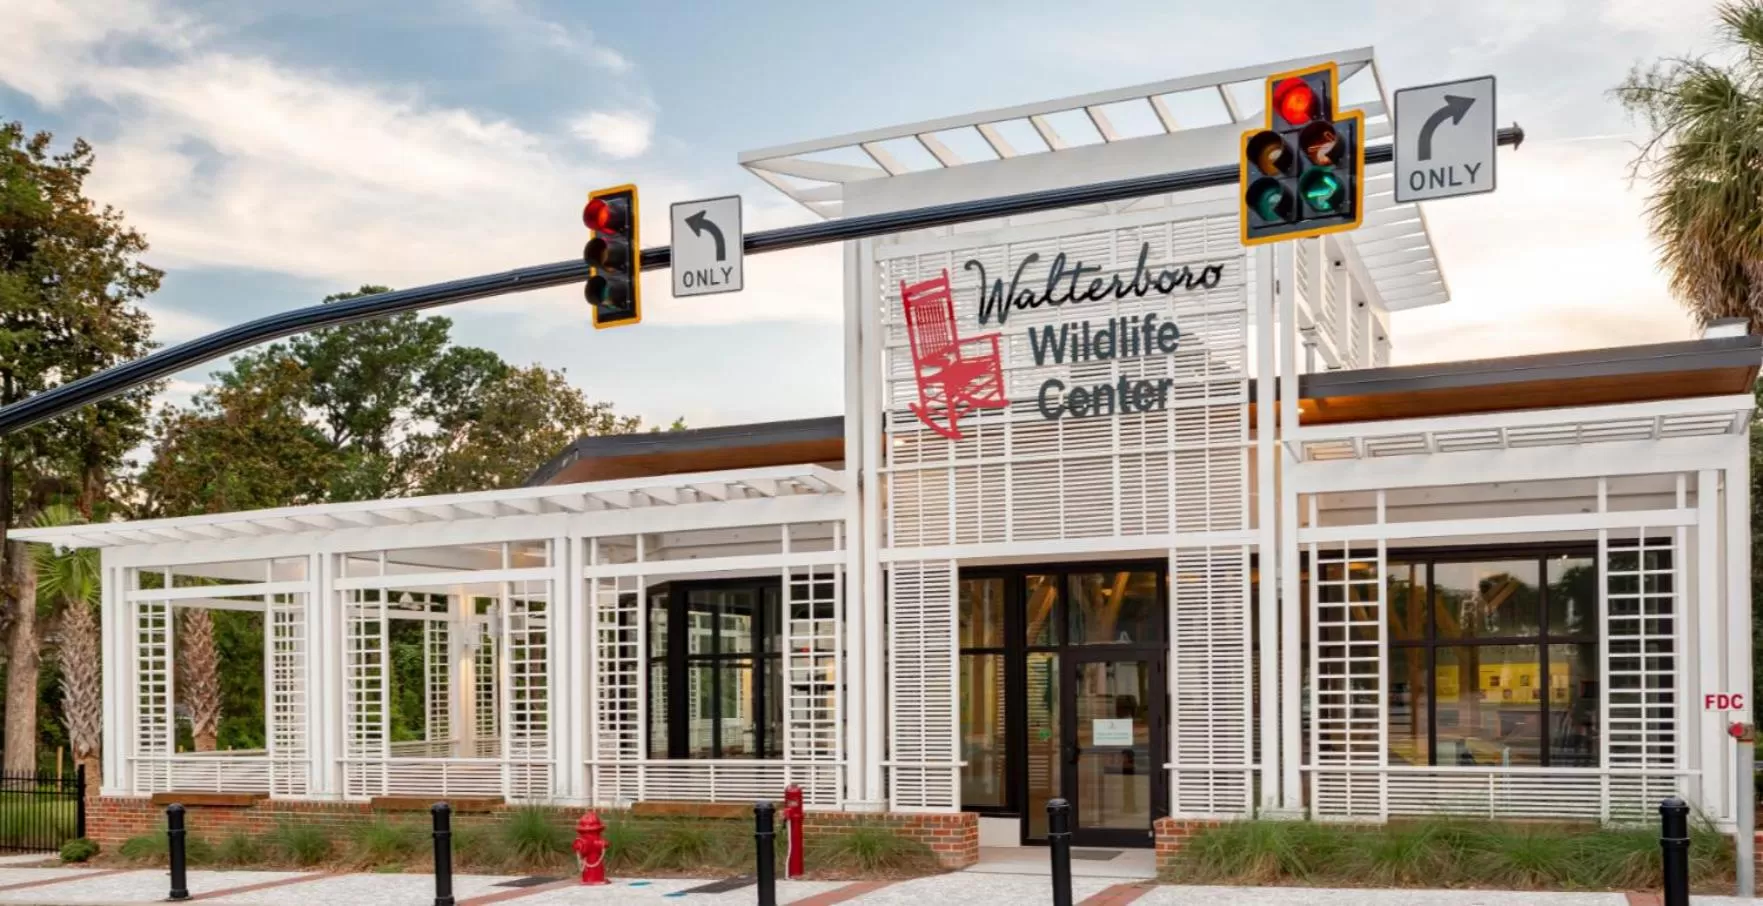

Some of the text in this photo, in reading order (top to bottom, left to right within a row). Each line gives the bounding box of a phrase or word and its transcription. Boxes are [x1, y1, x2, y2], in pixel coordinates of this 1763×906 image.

[1409, 162, 1482, 191] ONLY
[682, 266, 733, 288] ONLY
[964, 242, 1224, 325] Walterboro
[1028, 313, 1180, 366] Wildlife
[1038, 375, 1173, 420] Center
[1705, 694, 1744, 709] FDC
